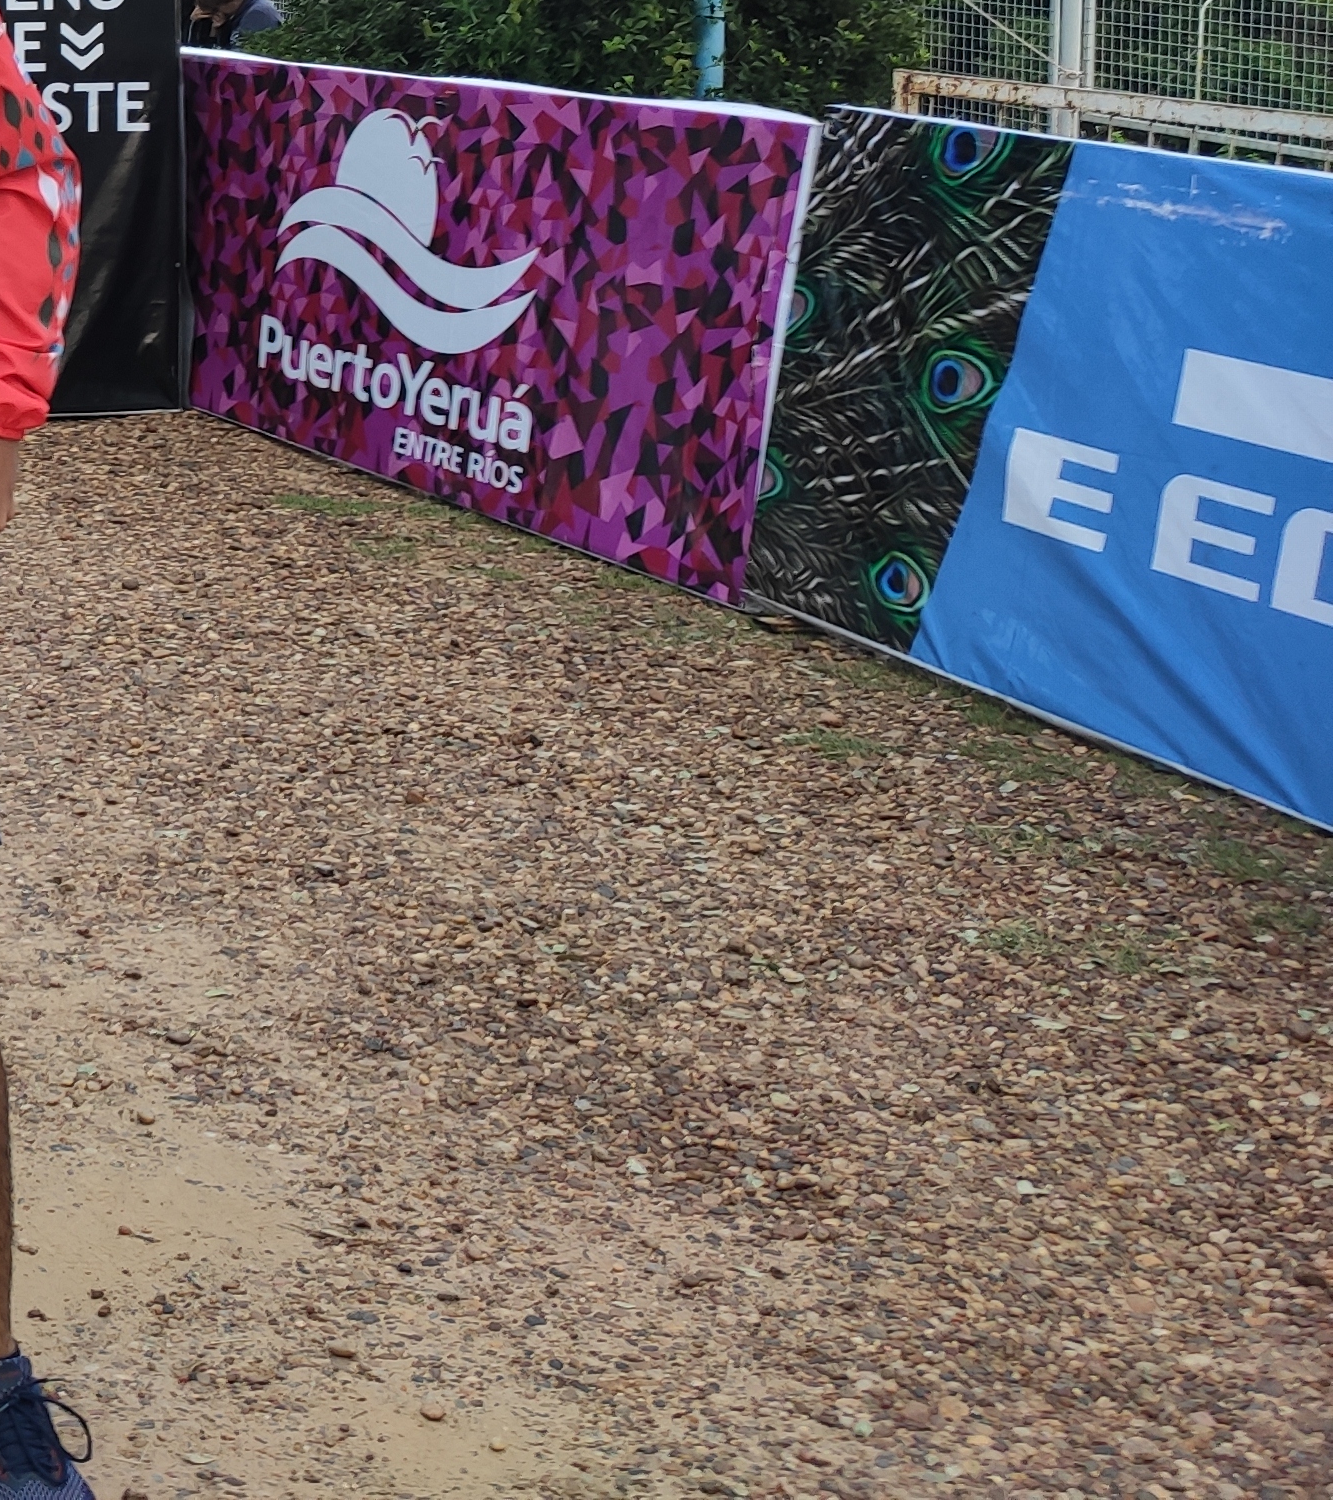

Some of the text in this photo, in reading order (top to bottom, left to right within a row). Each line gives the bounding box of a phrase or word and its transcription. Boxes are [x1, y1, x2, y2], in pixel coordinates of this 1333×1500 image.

[257, 313, 534, 454] PuertoYeruá
[392, 425, 525, 495] ENTRE RÍOS
